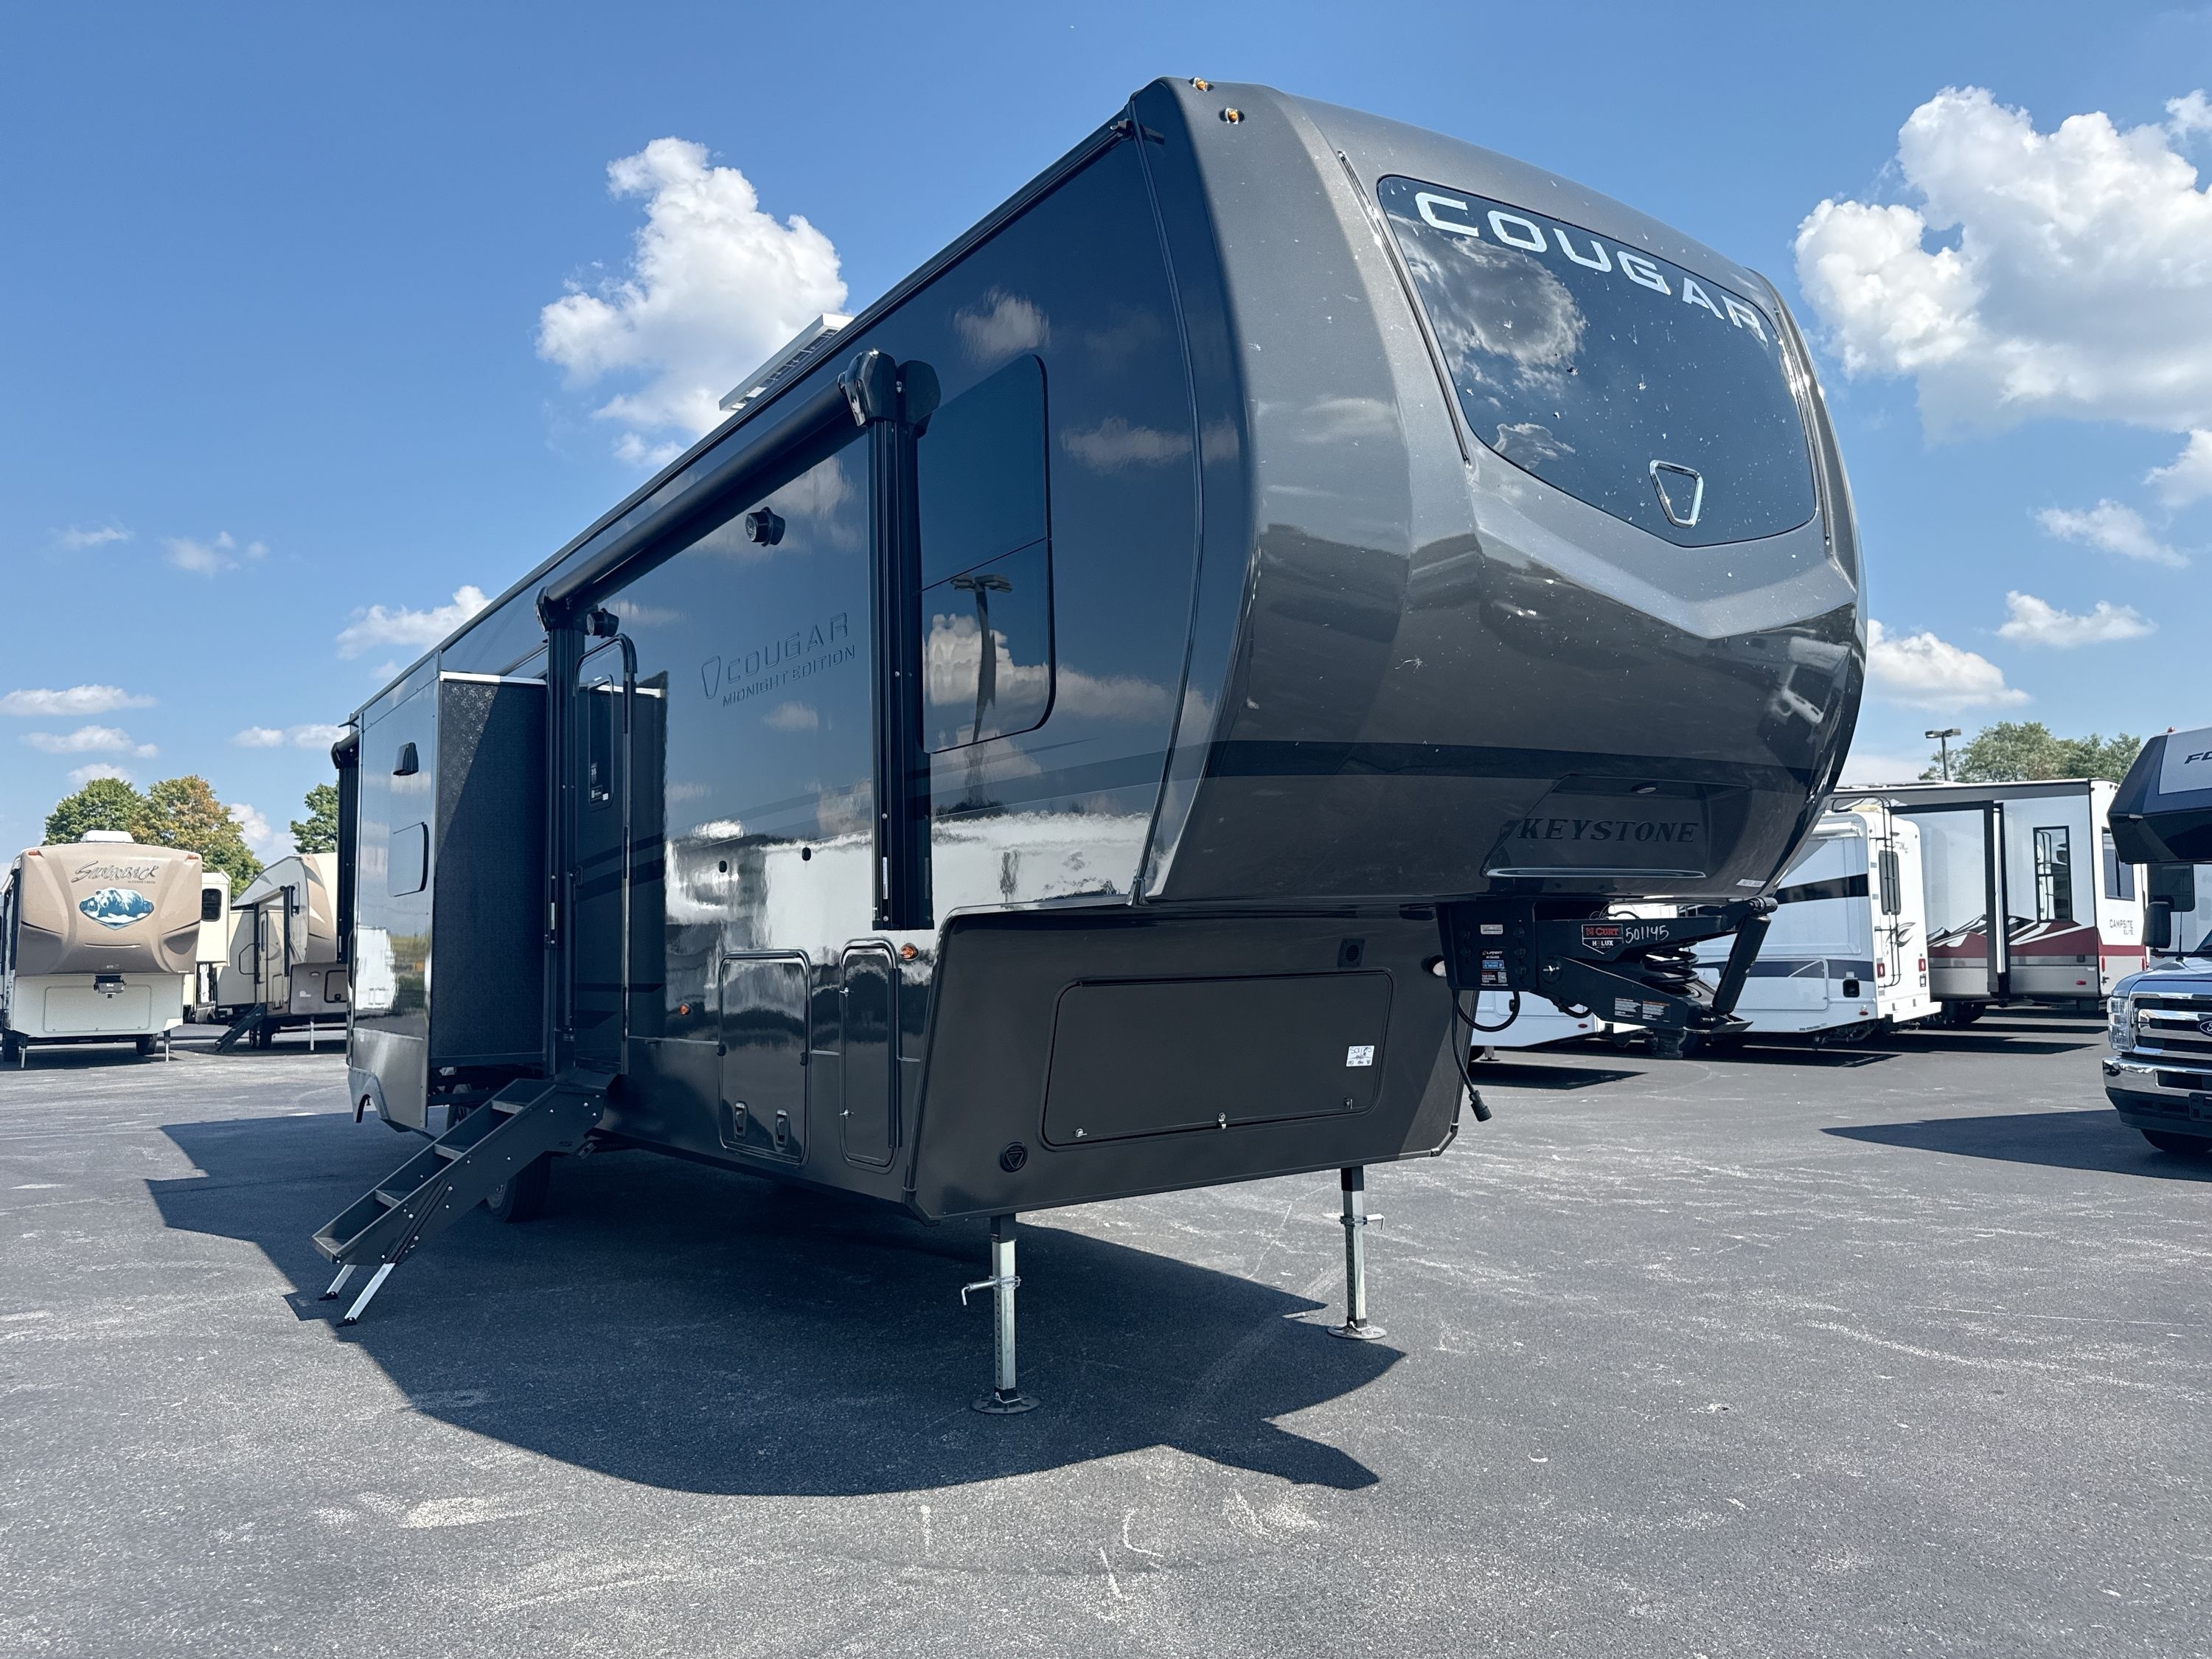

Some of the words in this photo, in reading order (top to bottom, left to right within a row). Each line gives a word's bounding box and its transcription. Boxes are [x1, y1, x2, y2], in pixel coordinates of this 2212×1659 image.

[1414, 191, 1769, 344] COUGAR
[727, 611, 849, 684] COUGAR
[723, 670, 789, 708] MIDNIGHT
[792, 644, 855, 681] EDITION
[1517, 817, 1699, 843] KEYSTONE
[1625, 925, 1669, 944] 501145
[2110, 919, 2134, 929] CAMPSITE
